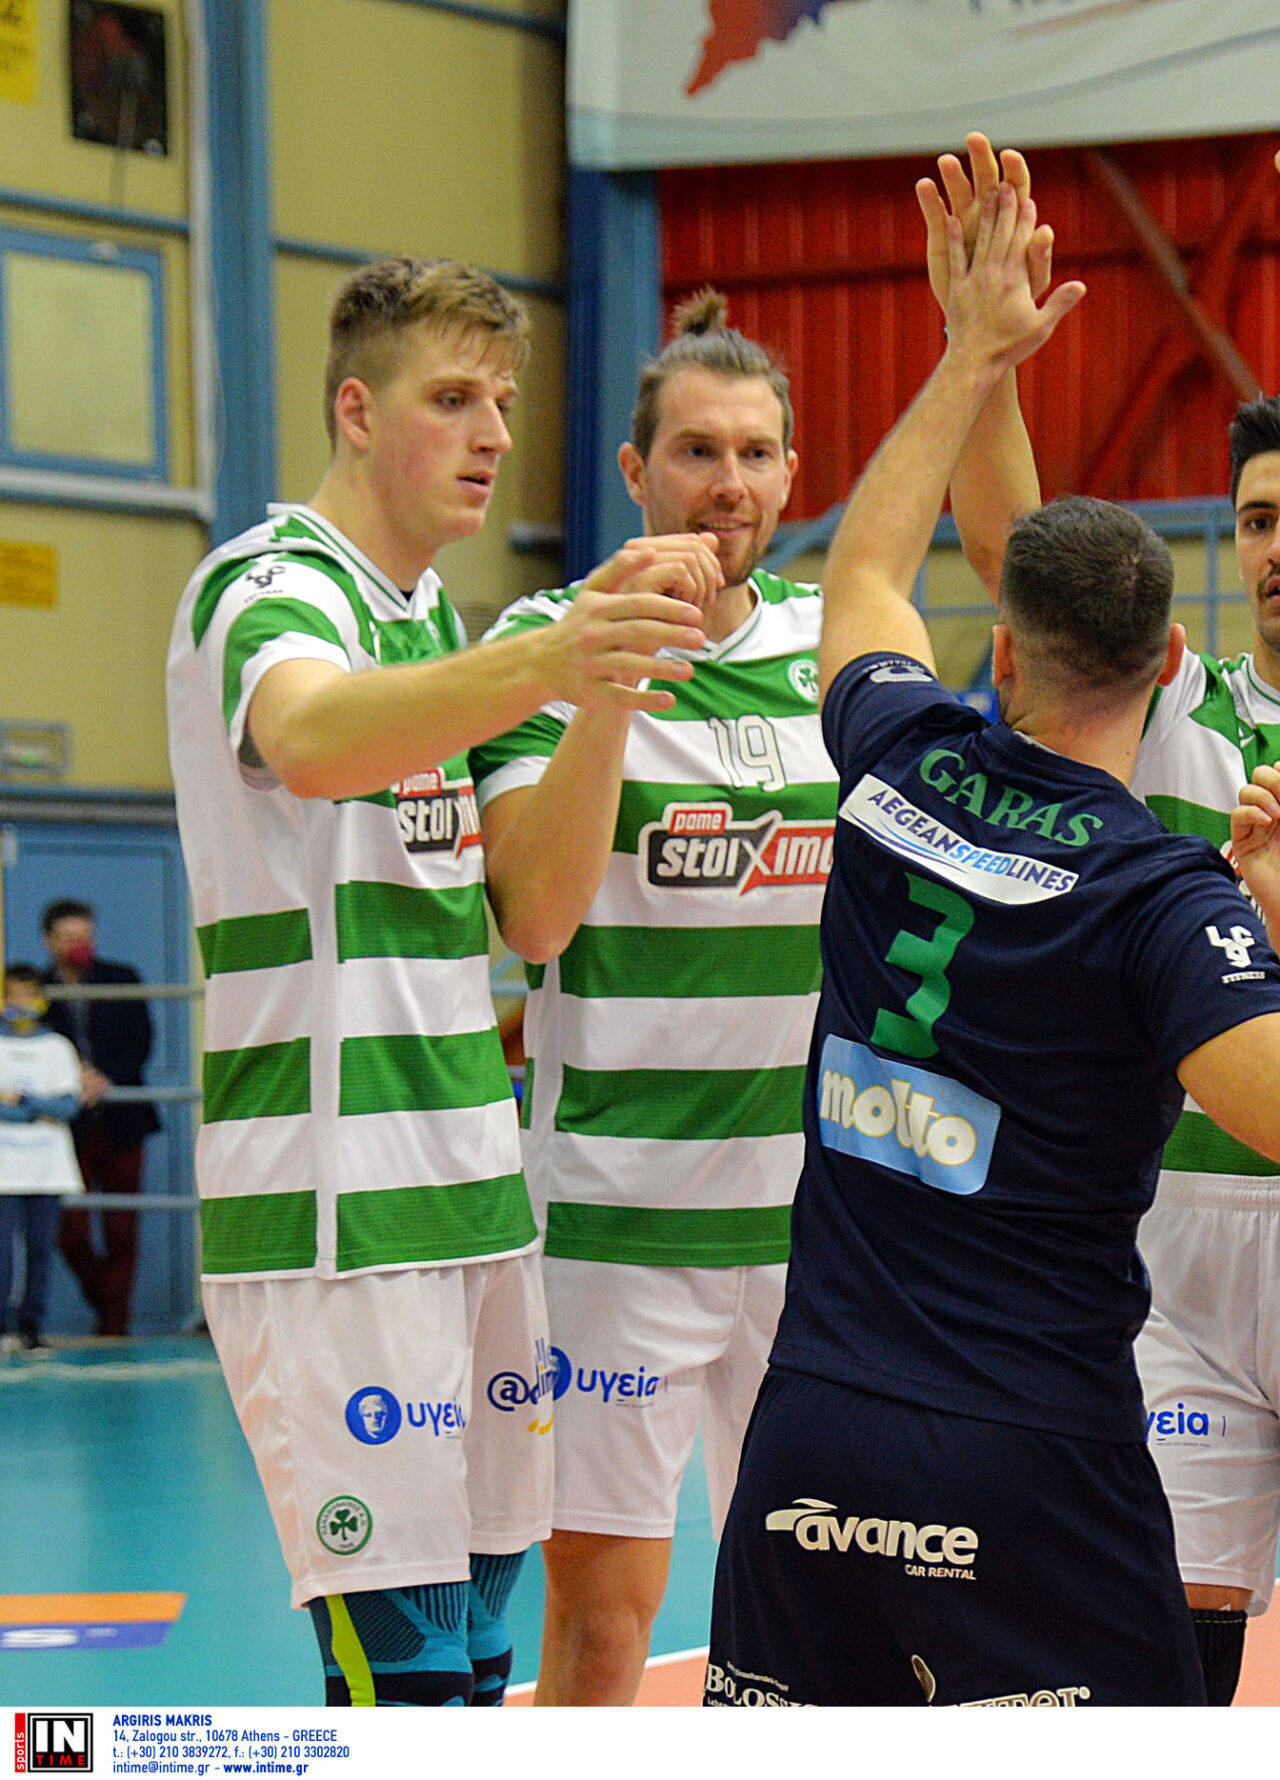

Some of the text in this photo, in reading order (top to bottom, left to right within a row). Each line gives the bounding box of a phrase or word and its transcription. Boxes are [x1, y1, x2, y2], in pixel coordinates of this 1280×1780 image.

[708, 714, 786, 792] 19
[918, 746, 1104, 848] GARAS
[870, 871, 975, 1059] 3
[795, 1515, 979, 1565] avance
[904, 1564, 976, 1581] CAR RENTAL
